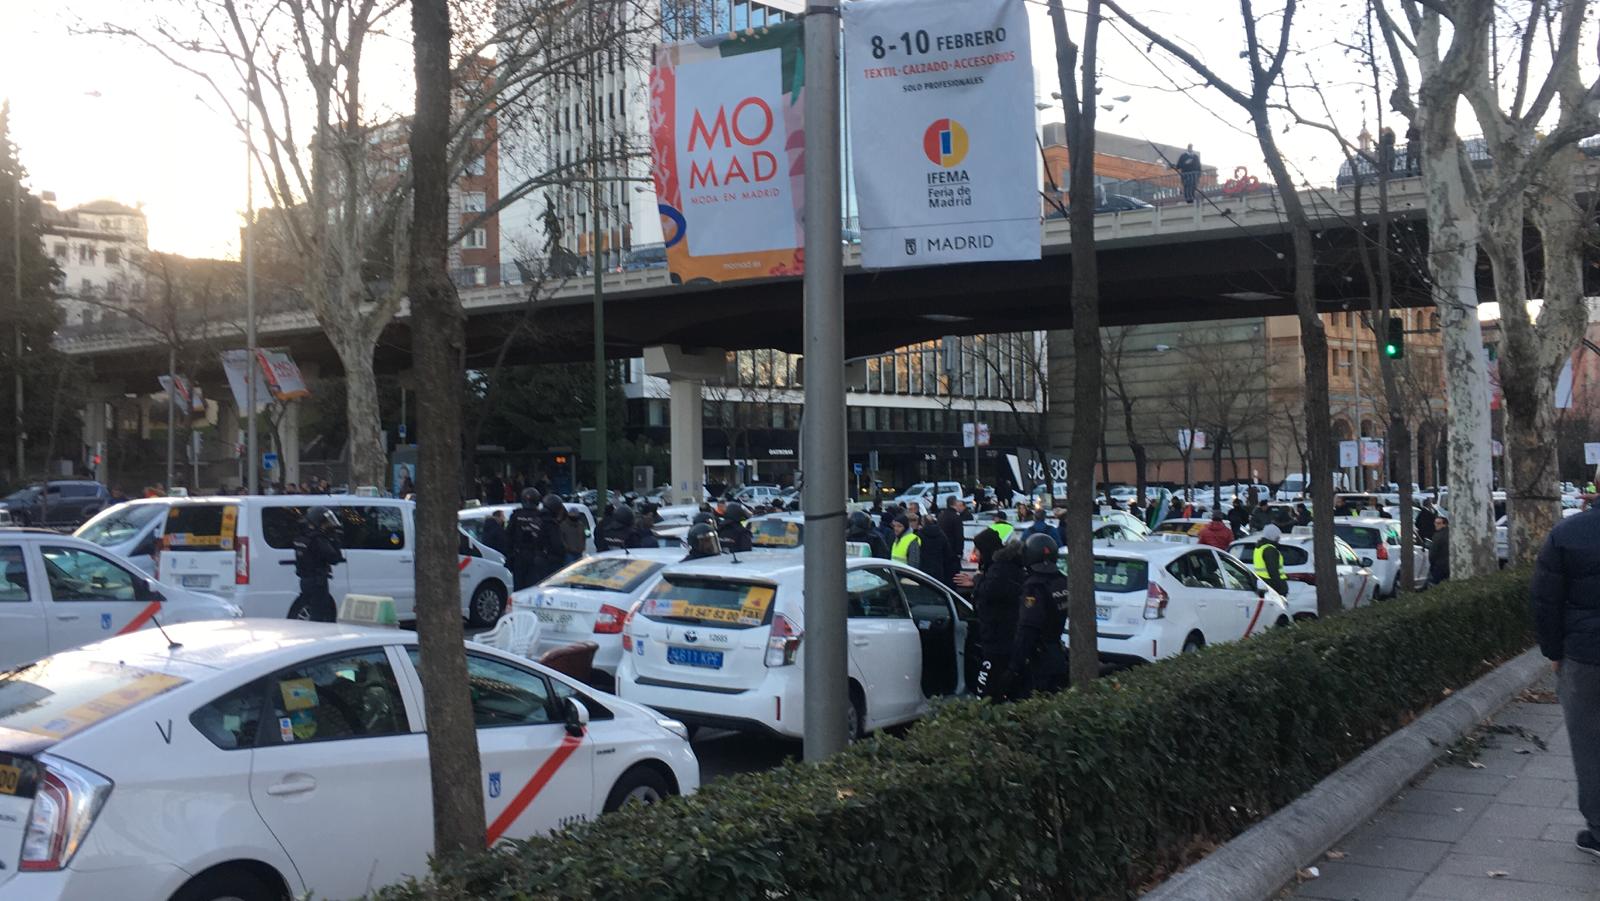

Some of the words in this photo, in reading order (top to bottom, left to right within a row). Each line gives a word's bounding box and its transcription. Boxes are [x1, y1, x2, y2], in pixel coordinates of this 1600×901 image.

[871, 29, 930, 59] 8-10
[936, 27, 1007, 51] FEBRERO
[902, 83, 923, 93] SOLO
[924, 76, 984, 90] PROFESIONALES
[687, 96, 774, 152] MO
[689, 150, 778, 189] MAD
[927, 169, 970, 184] IFEMA
[691, 195, 719, 205] MODA
[723, 193, 736, 201] EN
[742, 187, 780, 200] MADRID
[927, 186, 955, 198] Feria
[957, 185, 971, 196] de
[928, 195, 972, 208] Madrid
[927, 235, 994, 252] MADRID
[1049, 459, 1068, 480] 38
[155, 719, 172, 745] V
